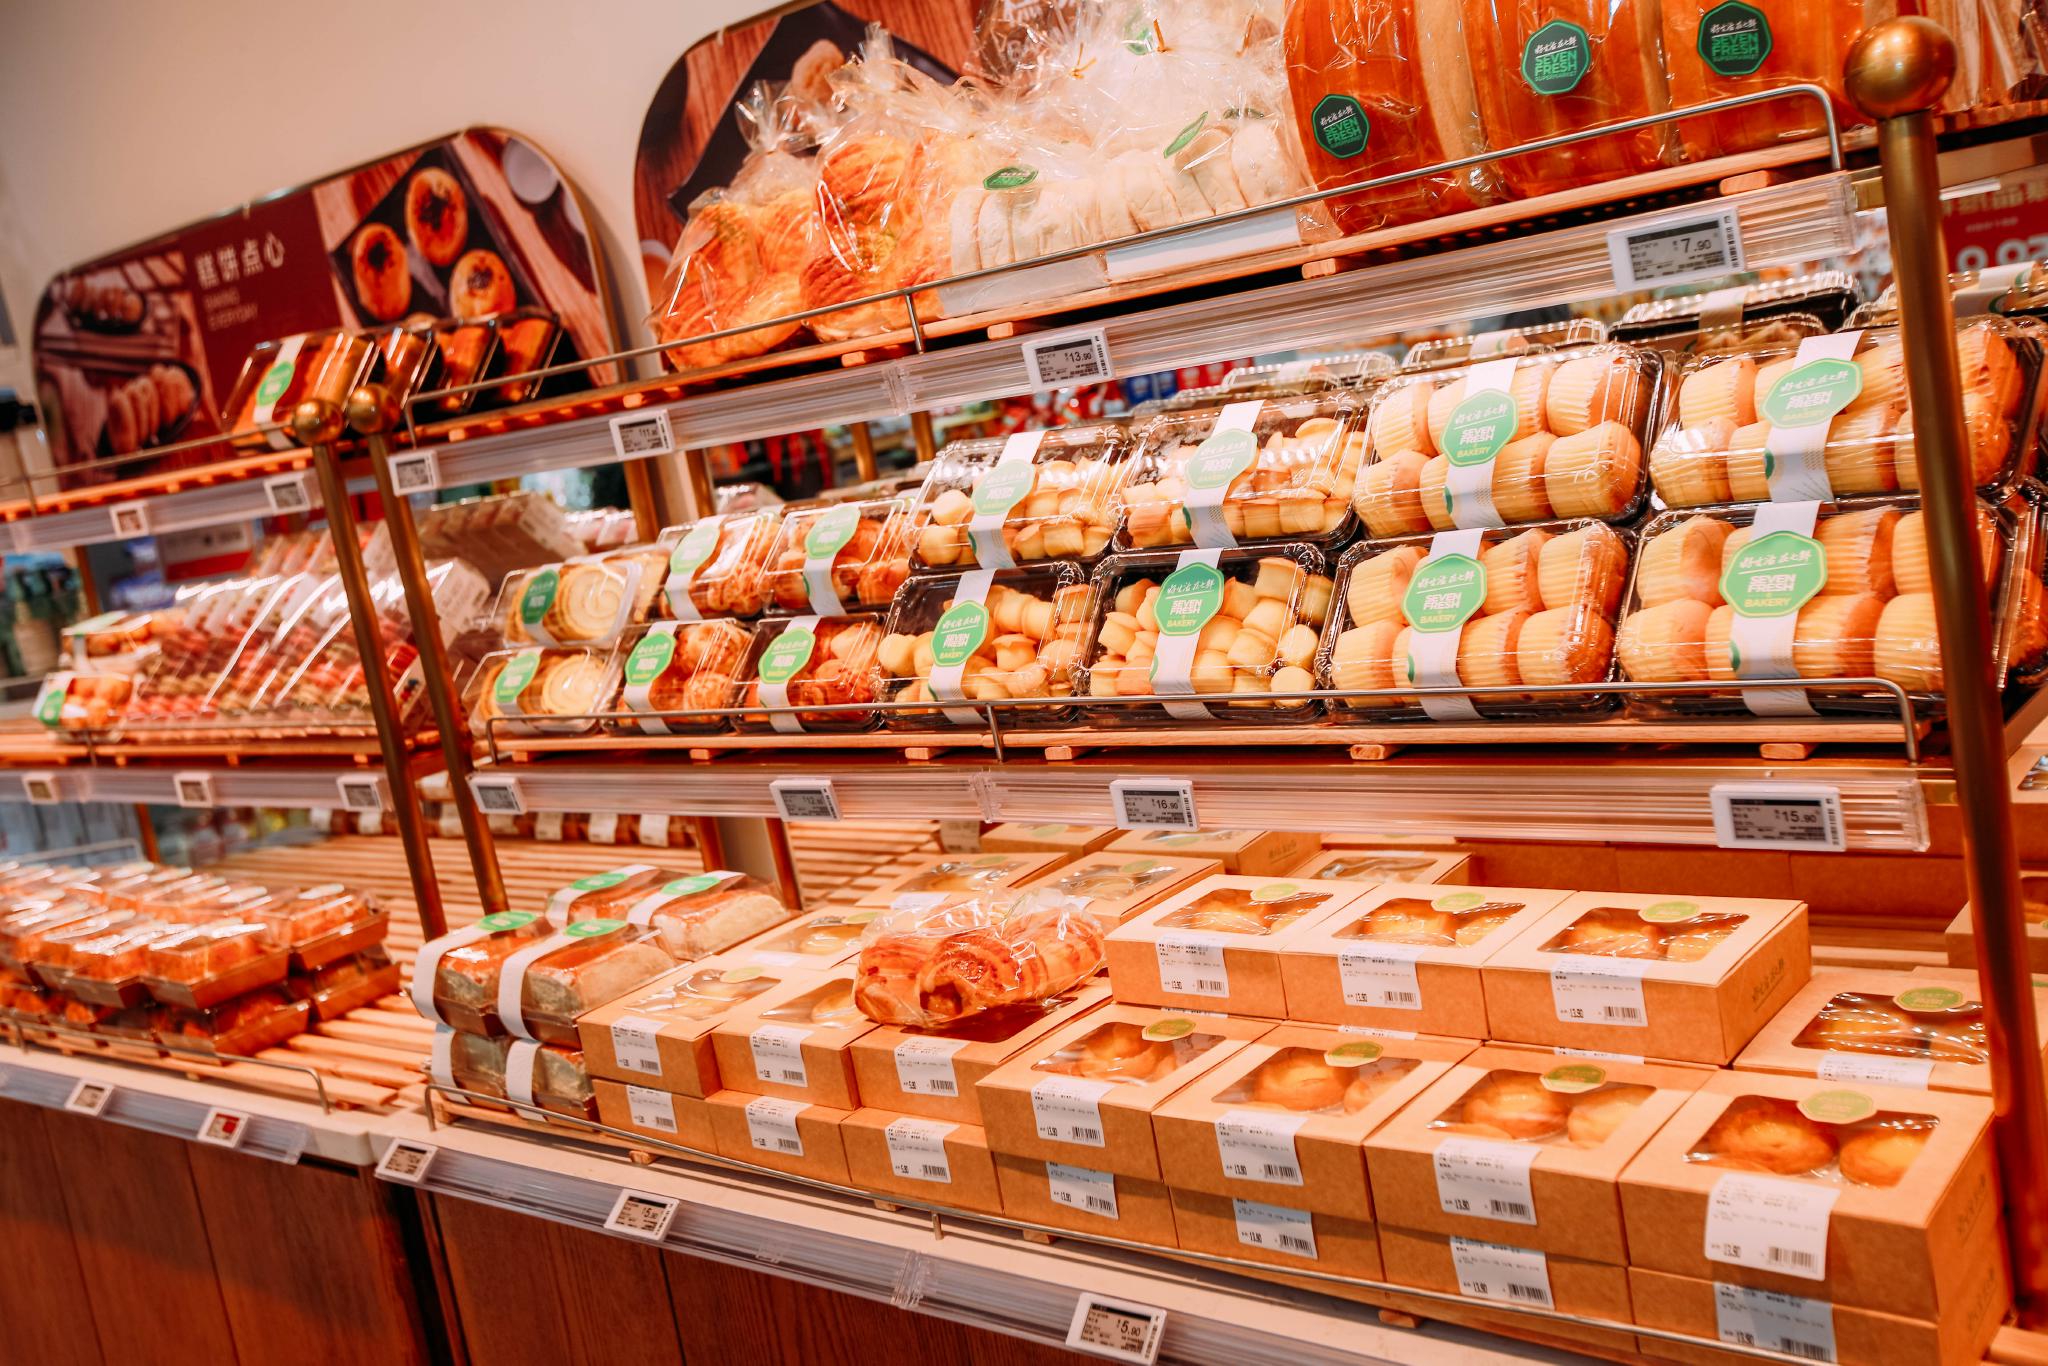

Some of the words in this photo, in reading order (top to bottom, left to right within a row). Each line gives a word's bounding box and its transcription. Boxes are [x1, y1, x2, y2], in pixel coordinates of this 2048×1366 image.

[1712, 33, 1759, 47] SEVEN
[1712, 44, 1759, 57] FRESH
[1535, 49, 1577, 66] SEVEN
[1534, 60, 1578, 76] FRESH
[1325, 117, 1359, 135] SEVEN
[1326, 126, 1362, 145] FRESH
[1789, 391, 1832, 403] SEVEN
[1786, 397, 1831, 410] FRESH
[1461, 426, 1496, 438] SEVEN
[1460, 432, 1495, 445] FRESH
[1750, 574, 1797, 584] SEVEN
[1747, 582, 1796, 592] FRESH
[1425, 592, 1462, 602] SEVEN
[1744, 597, 1792, 608] BAKERY
[1172, 599, 1202, 608] SEVEN
[1423, 599, 1461, 610] FRESH
[1169, 606, 1201, 615] FRESH
[1420, 614, 1457, 624] BAKERY
